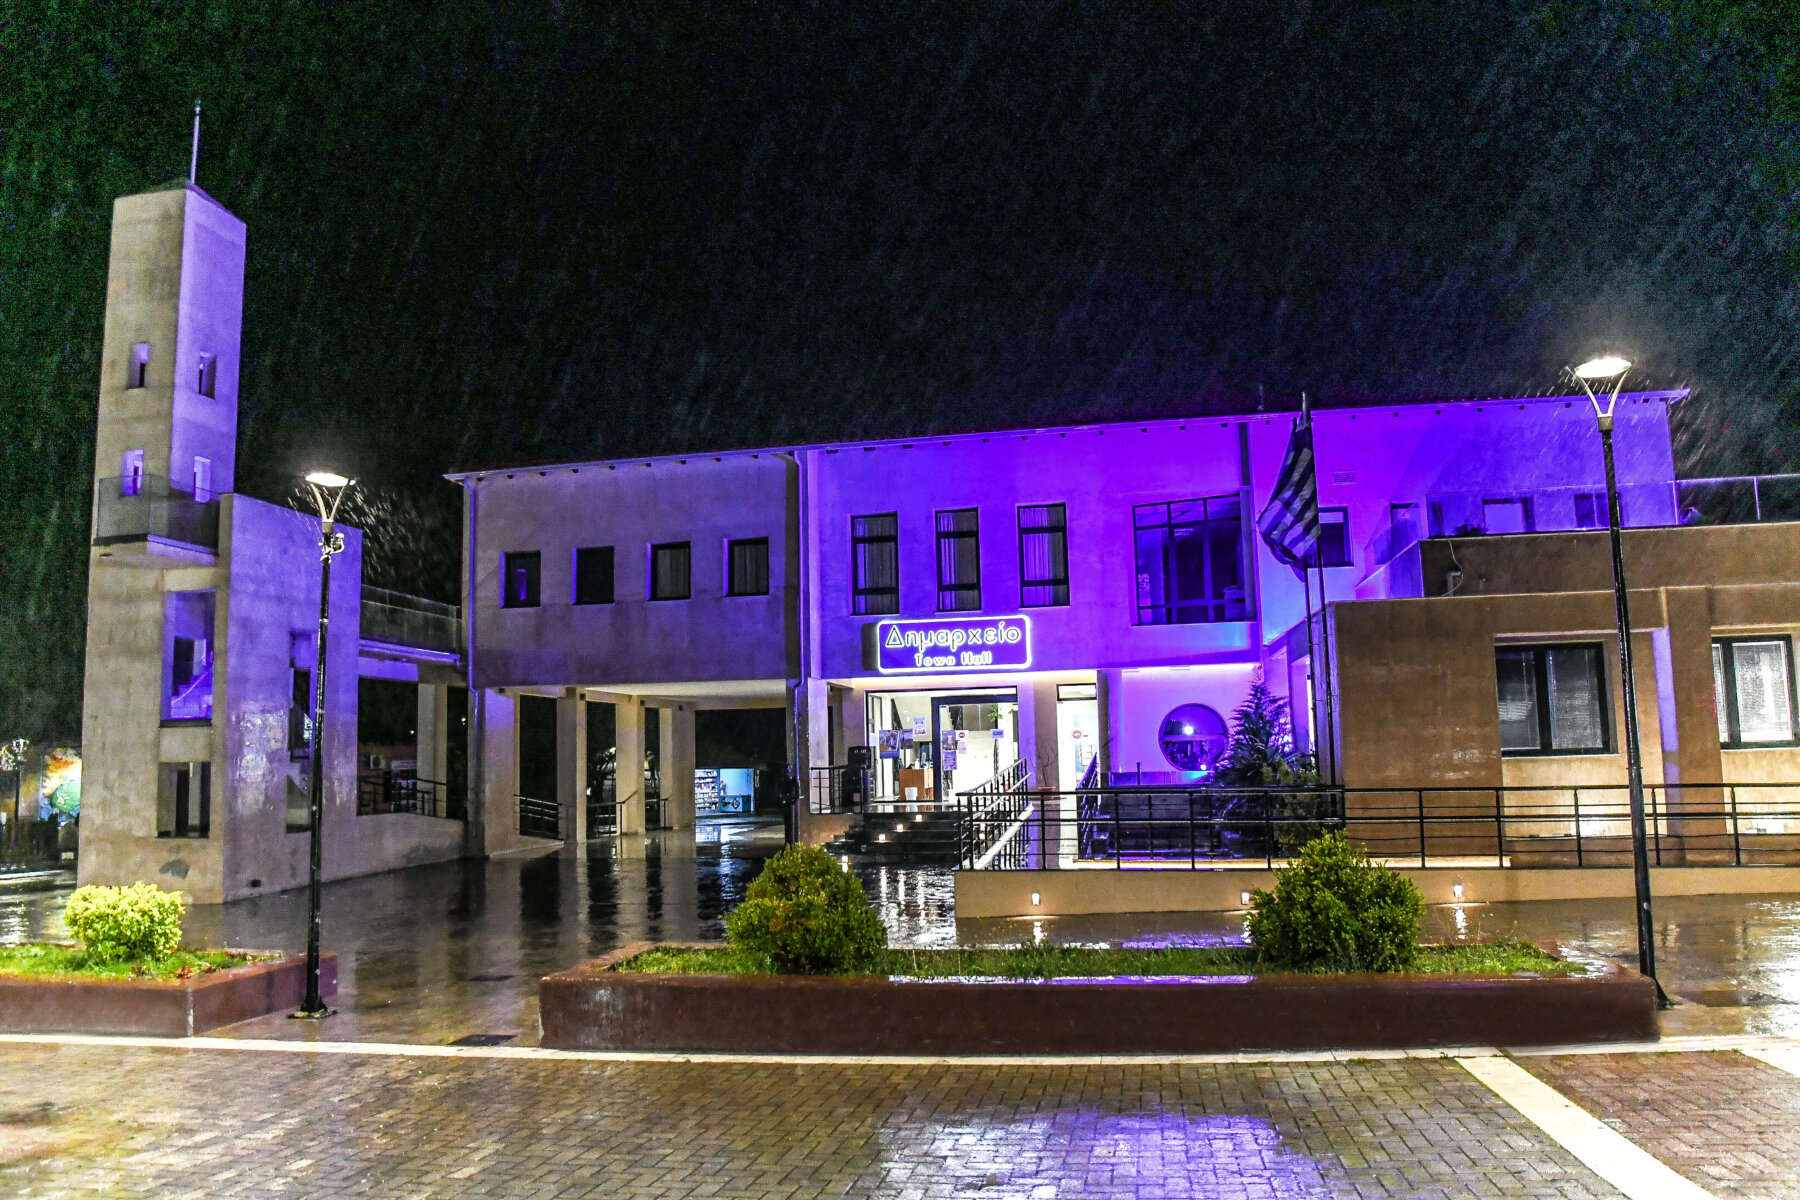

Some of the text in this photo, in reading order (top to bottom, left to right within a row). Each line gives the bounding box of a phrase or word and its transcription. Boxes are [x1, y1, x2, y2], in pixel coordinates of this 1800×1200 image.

[886, 622, 1021, 652] Δημαρχείο
[915, 651, 993, 667] Town Hall
